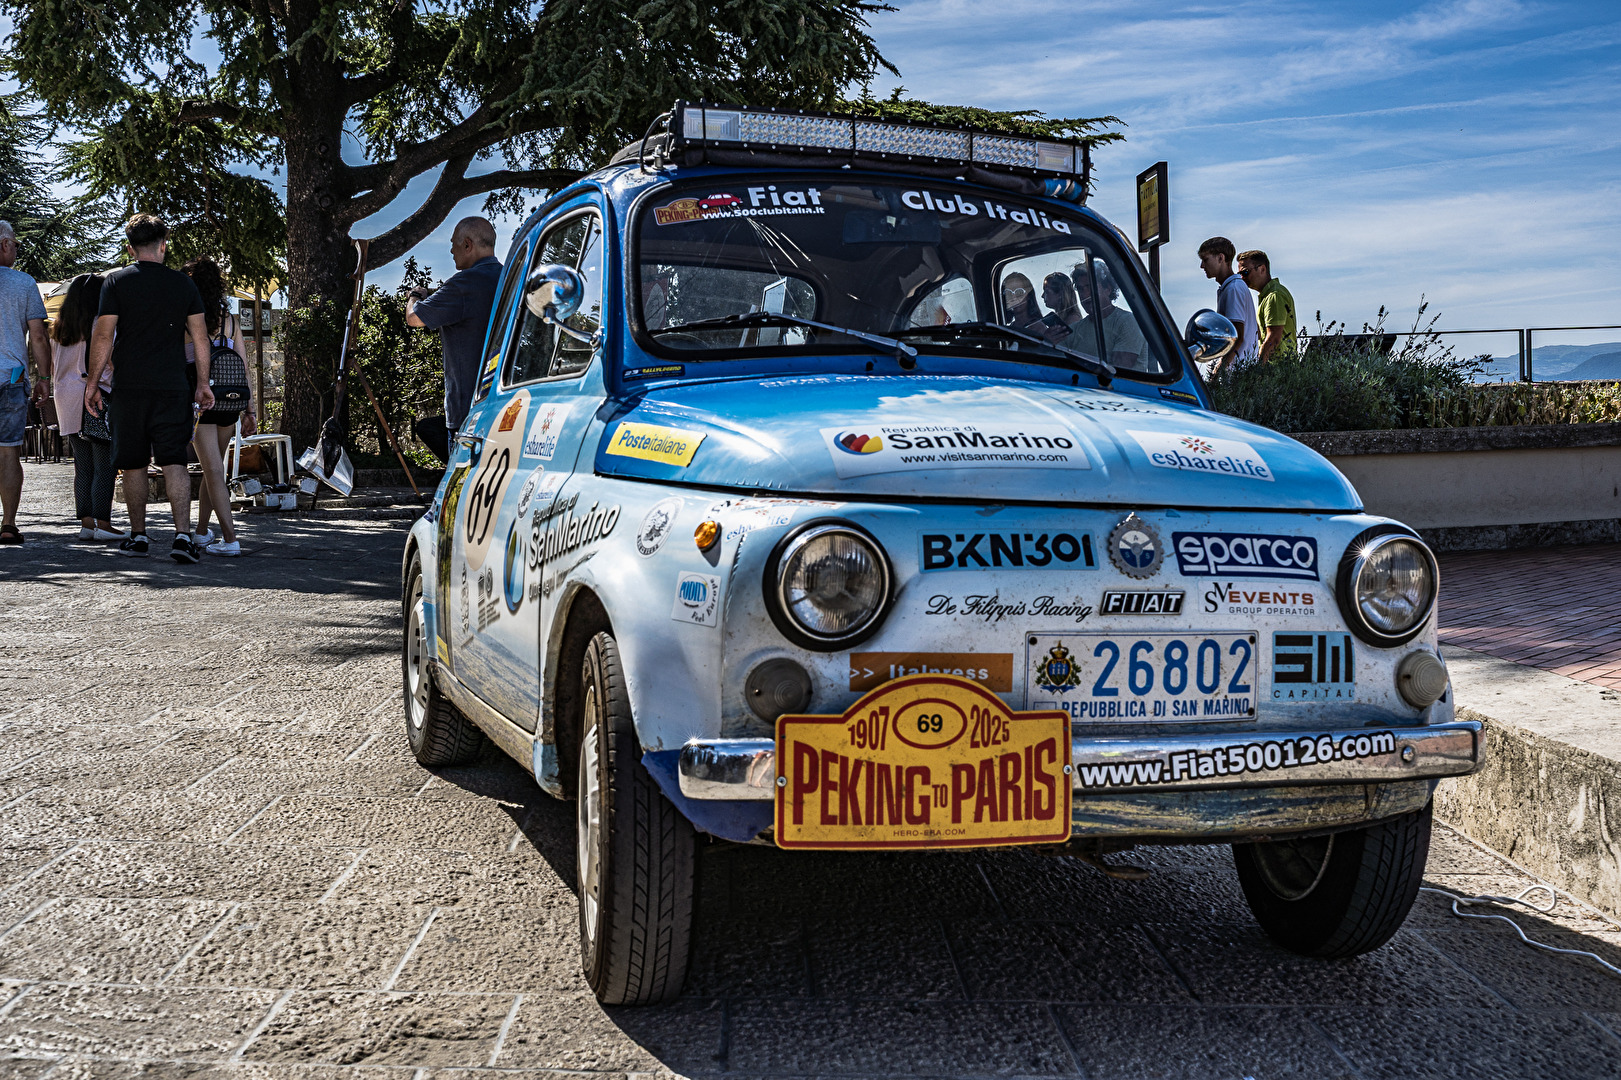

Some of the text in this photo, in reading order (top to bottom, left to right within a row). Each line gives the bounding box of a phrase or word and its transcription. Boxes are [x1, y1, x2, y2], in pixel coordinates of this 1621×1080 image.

[657, 209, 690, 223] PEKING
[748, 185, 1072, 235] Fiat Club Italia
[618, 429, 687, 456] Posteitaliane
[881, 425, 960, 435] Repubblica
[888, 431, 1073, 450] SanMarino
[900, 451, 1068, 464] www.visitsanmarino.com
[1152, 450, 1269, 479] esharelife
[466, 446, 510, 546] 69
[529, 500, 621, 569] SanMarino
[922, 533, 1095, 570] BKN301
[1178, 536, 1315, 574] sparco
[925, 594, 956, 616] De
[1028, 596, 1093, 623] Racing
[1107, 593, 1182, 613] FIAT
[1228, 591, 1315, 605] EVENTS
[1229, 606, 1316, 616] GROUP OPERATOR
[1092, 639, 1252, 696] 26802
[1061, 697, 1250, 719] REPUBBLICA DI SAN MARINO
[1274, 689, 1353, 699] CAPITAL
[847, 706, 890, 750] 1907
[917, 714, 943, 733] 69
[970, 704, 1010, 749] 2025
[1080, 730, 1396, 787] www.Fiat500126.com
[793, 737, 1056, 826] PEKING TO PARIS
[893, 828, 966, 837] HERO-ERA.COM
